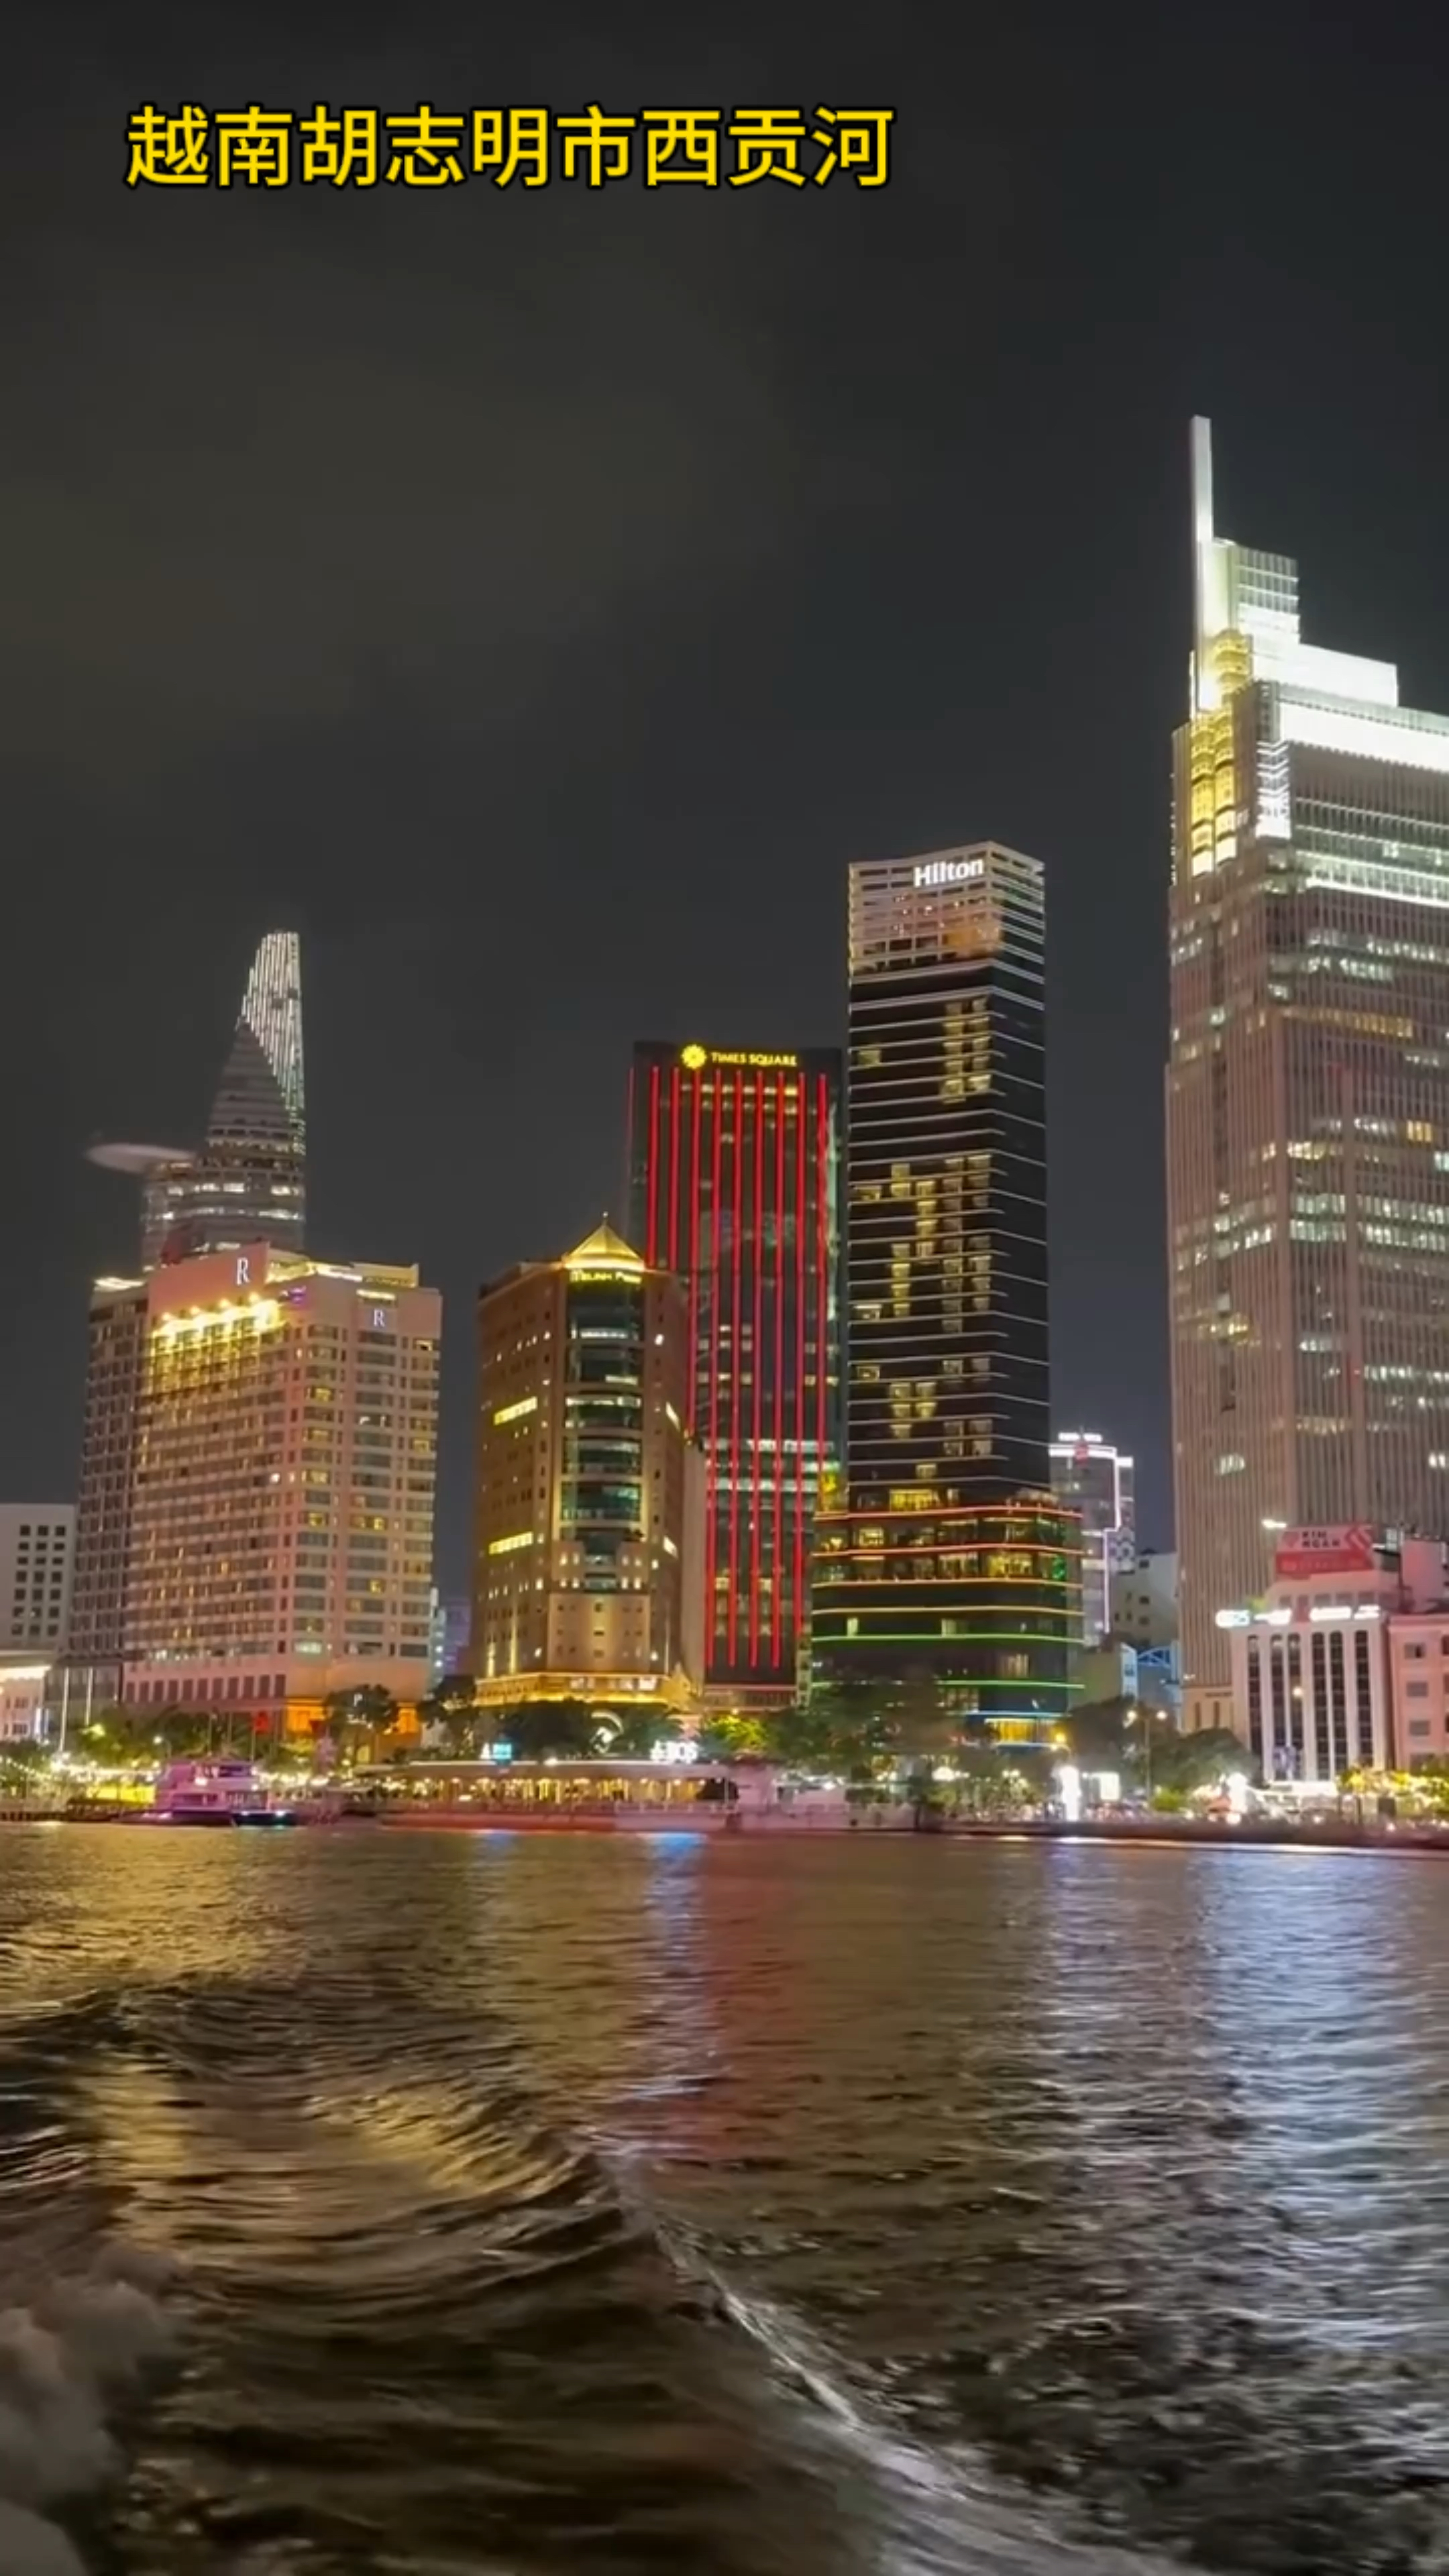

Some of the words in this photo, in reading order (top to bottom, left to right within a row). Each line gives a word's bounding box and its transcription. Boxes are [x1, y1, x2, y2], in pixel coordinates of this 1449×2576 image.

[914, 859, 984, 888] Hilton
[711, 1051, 746, 1064] TIMES
[749, 1053, 797, 1067] SQUARE
[236, 1257, 250, 1285] R
[373, 1309, 385, 1327] R
